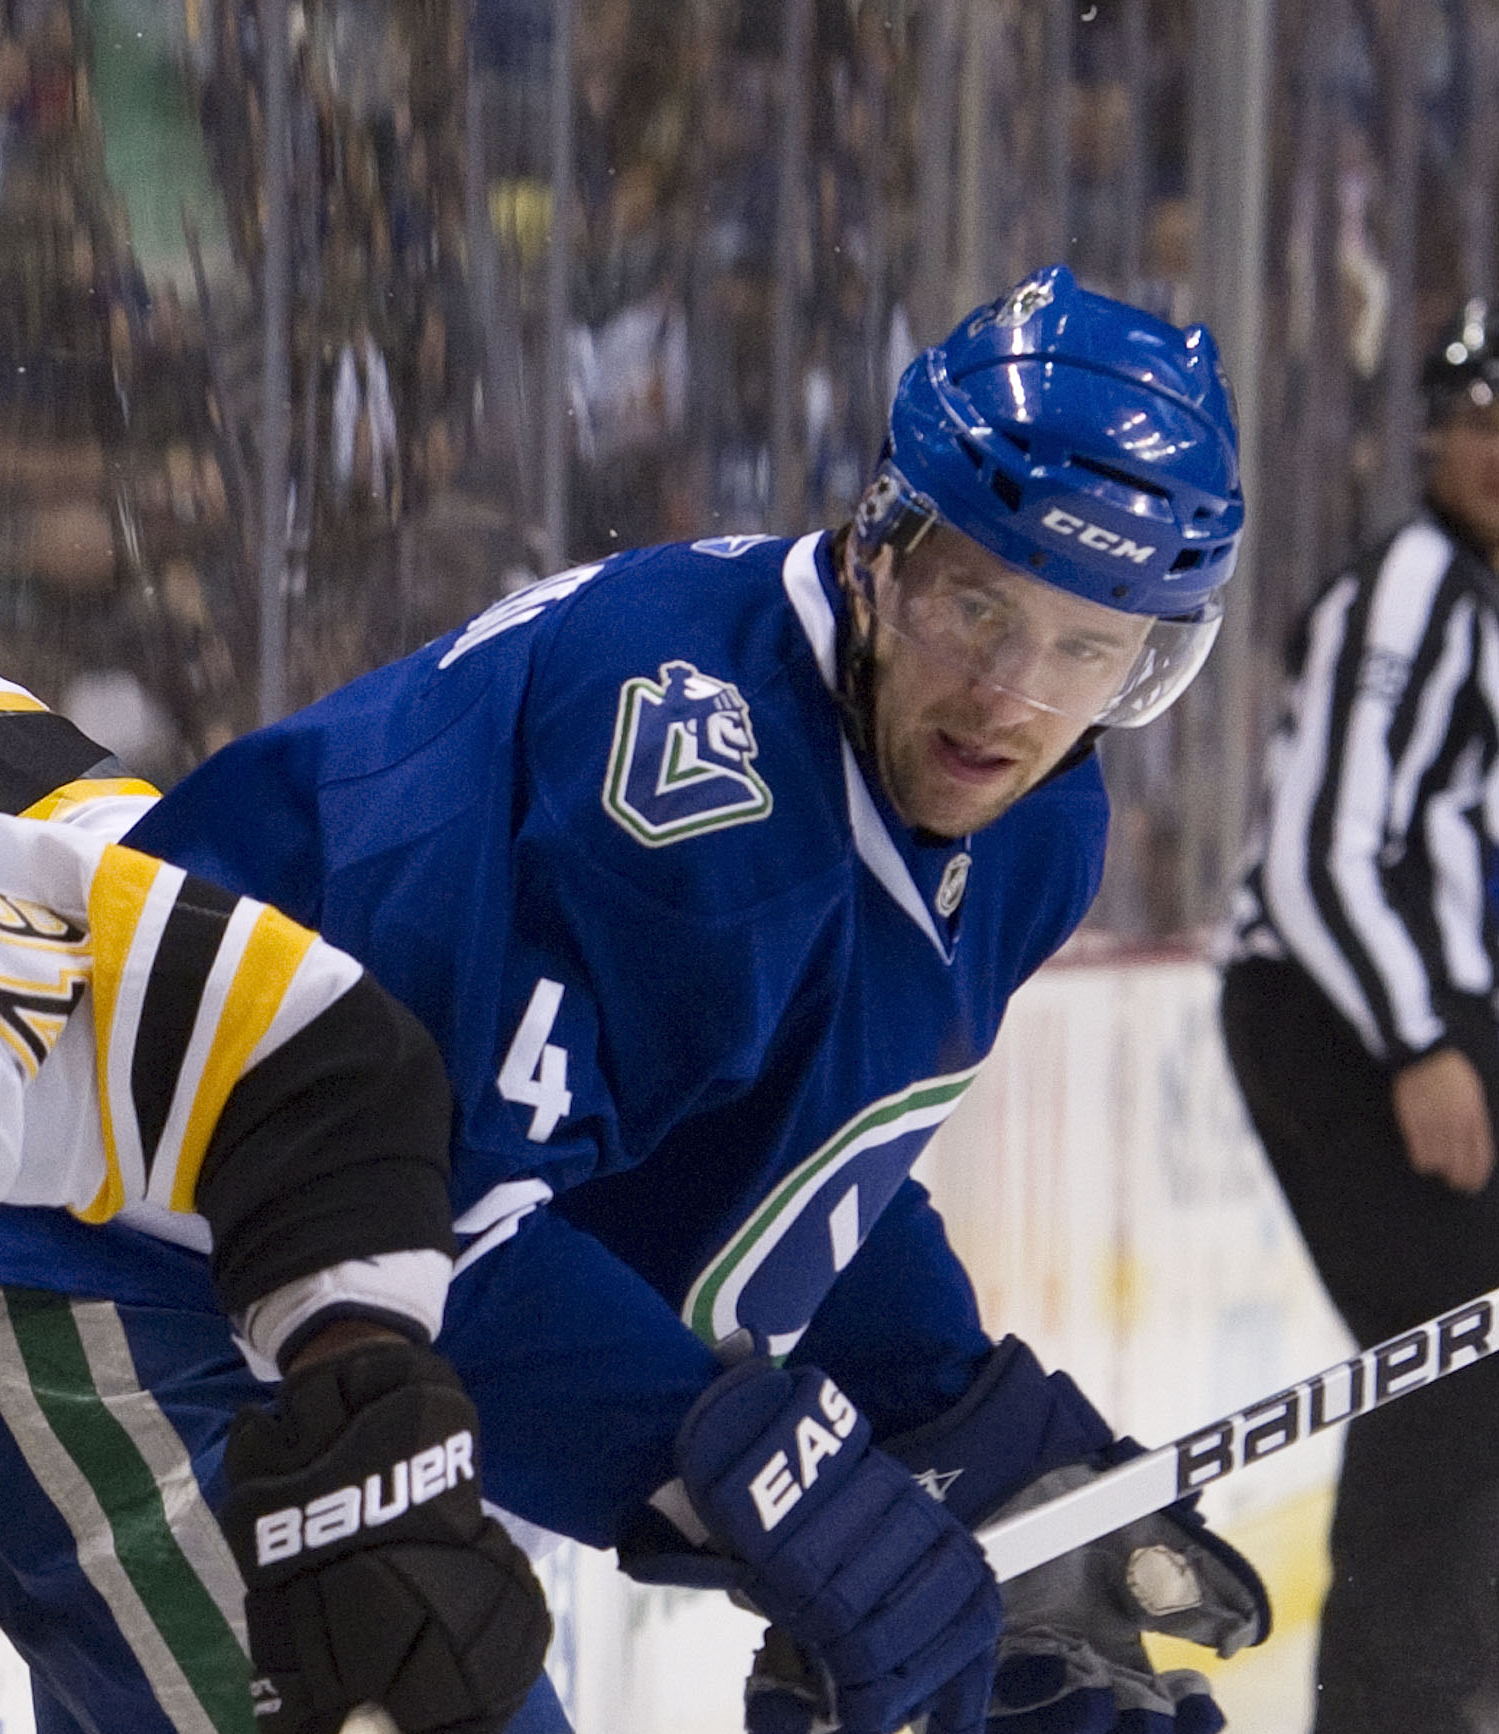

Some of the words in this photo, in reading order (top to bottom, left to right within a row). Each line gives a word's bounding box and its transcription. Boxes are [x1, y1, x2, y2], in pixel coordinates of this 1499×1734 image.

[1041, 507, 1156, 564] CCM
[496, 976, 572, 1143] 4
[1176, 1300, 1492, 1500] BAUER
[256, 1430, 475, 1567] BAUER
